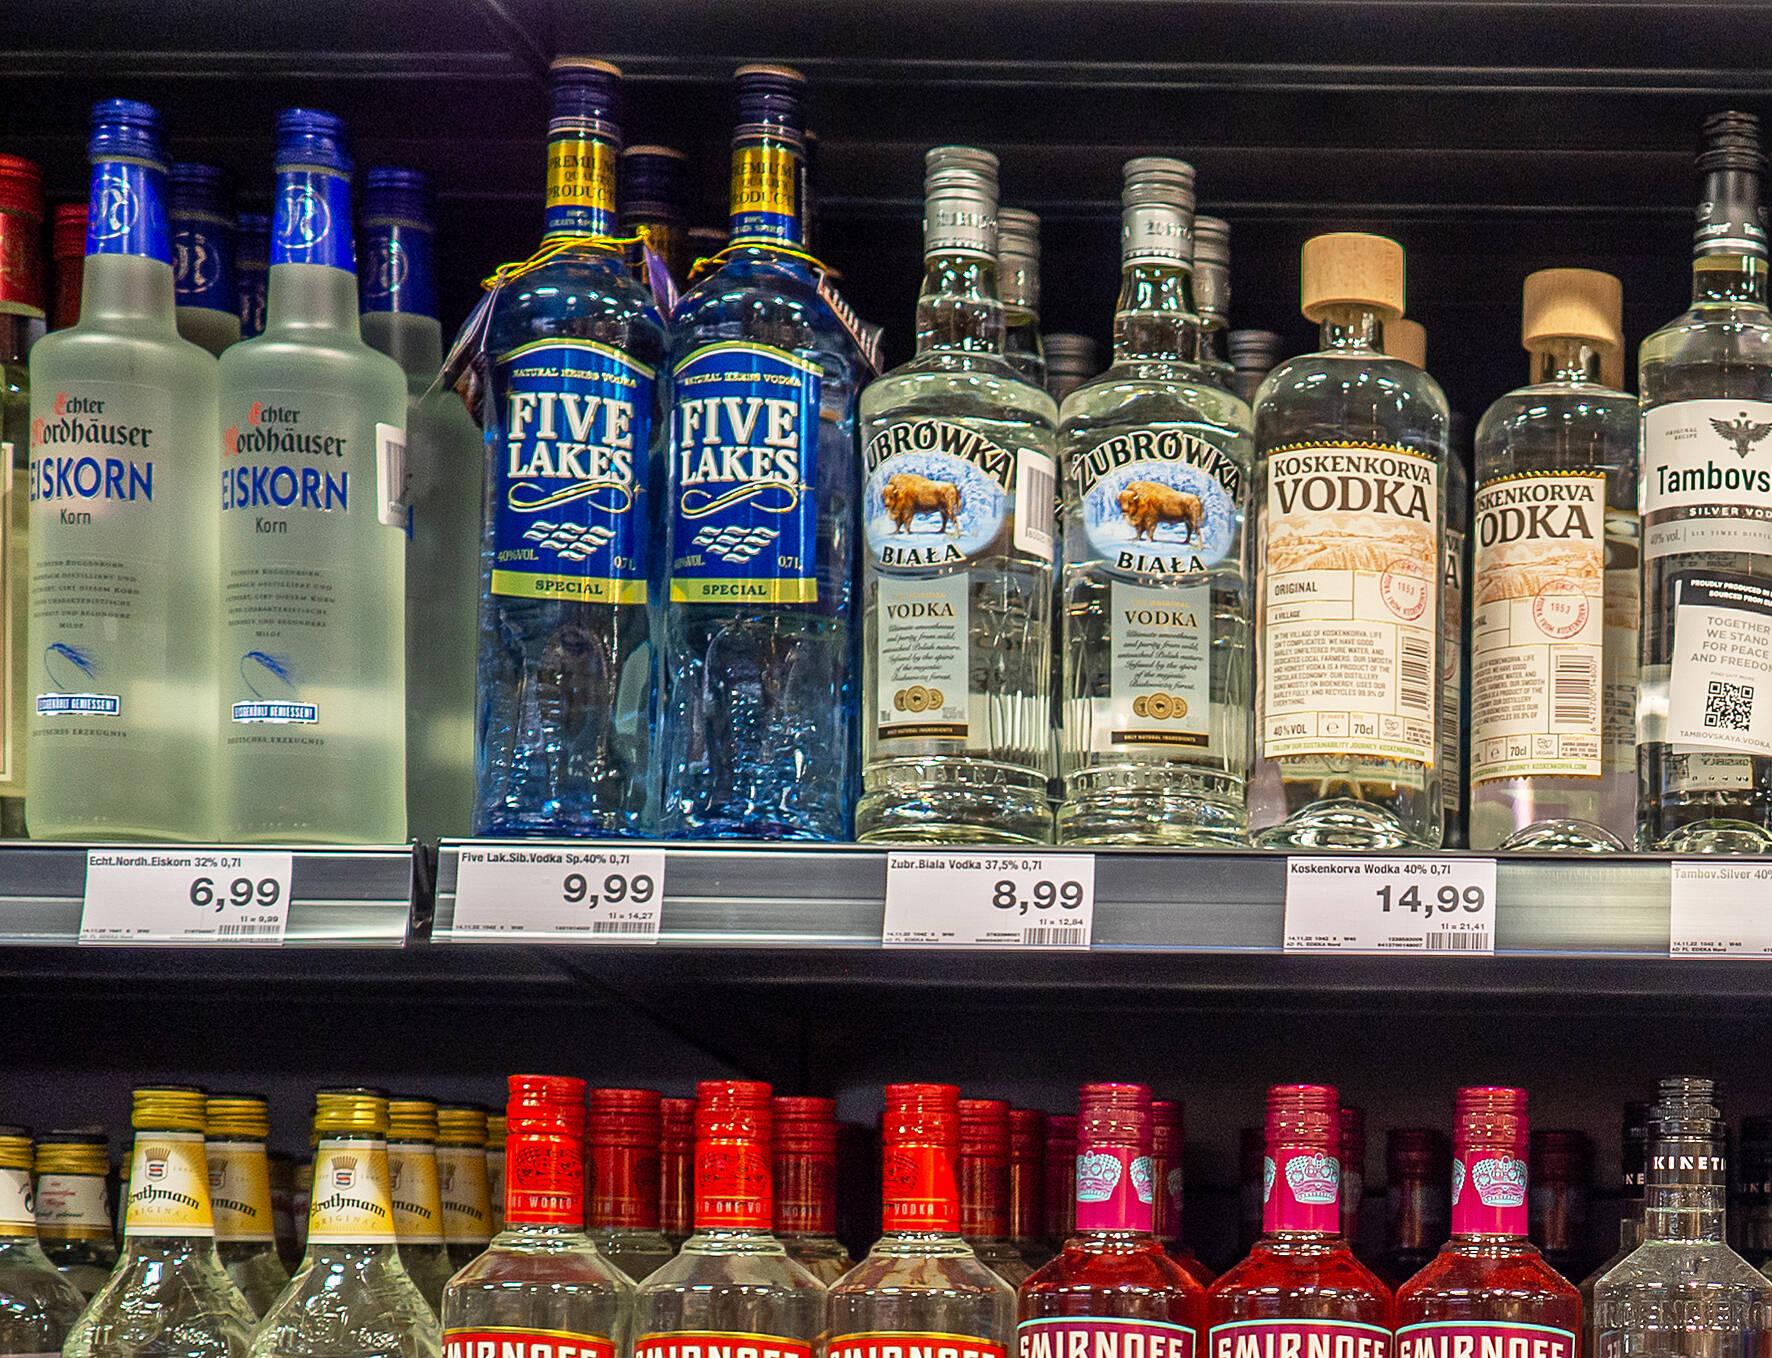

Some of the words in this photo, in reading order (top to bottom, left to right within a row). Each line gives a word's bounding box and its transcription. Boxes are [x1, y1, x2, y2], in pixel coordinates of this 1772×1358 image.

[248, 401, 301, 426] Echter
[508, 393, 634, 448] FIVE
[681, 397, 798, 449] FIVE
[508, 442, 634, 486] LAKES
[681, 445, 799, 487] LAKES
[1273, 455, 1432, 487] KOSKENKORVA
[30, 456, 154, 502] EISKORN
[222, 465, 349, 512] EISKORN
[1273, 476, 1432, 522] VODKA
[60, 509, 92, 525] Korn
[1688, 506, 1741, 518] SILVER
[256, 517, 288, 534] Korn
[881, 544, 967, 566] BIAŁA
[1116, 551, 1207, 574] BIAŁA
[535, 580, 603, 596] SPECIAL
[702, 583, 768, 596] SPECIAL
[1274, 580, 1318, 595] ORIGINAL
[886, 603, 956, 619] VODKA
[1124, 610, 1198, 628] VODKA
[1707, 616, 1771, 636] TOGETHER
[1706, 628, 1728, 641] WE
[1731, 631, 1770, 647] STAND
[1691, 652, 1716, 665] AND
[1702, 640, 1727, 653] FOR
[1730, 644, 1769, 659] PEACE
[1354, 724, 1373, 735] 70cl
[1679, 730, 1771, 749] TAMBOVSKAYA.VODKA
[89, 855, 192, 868] Echt.Nordh.Eiskorn
[194, 857, 218, 868] 32%
[1291, 863, 1361, 876] Koskenkorva
[1364, 863, 1400, 875] Wodka
[1404, 863, 1427, 875] 40%
[189, 876, 281, 913] 6,99
[563, 873, 656, 910] 9,99
[991, 880, 1083, 916] 8,99
[1376, 884, 1486, 920] 14,99
